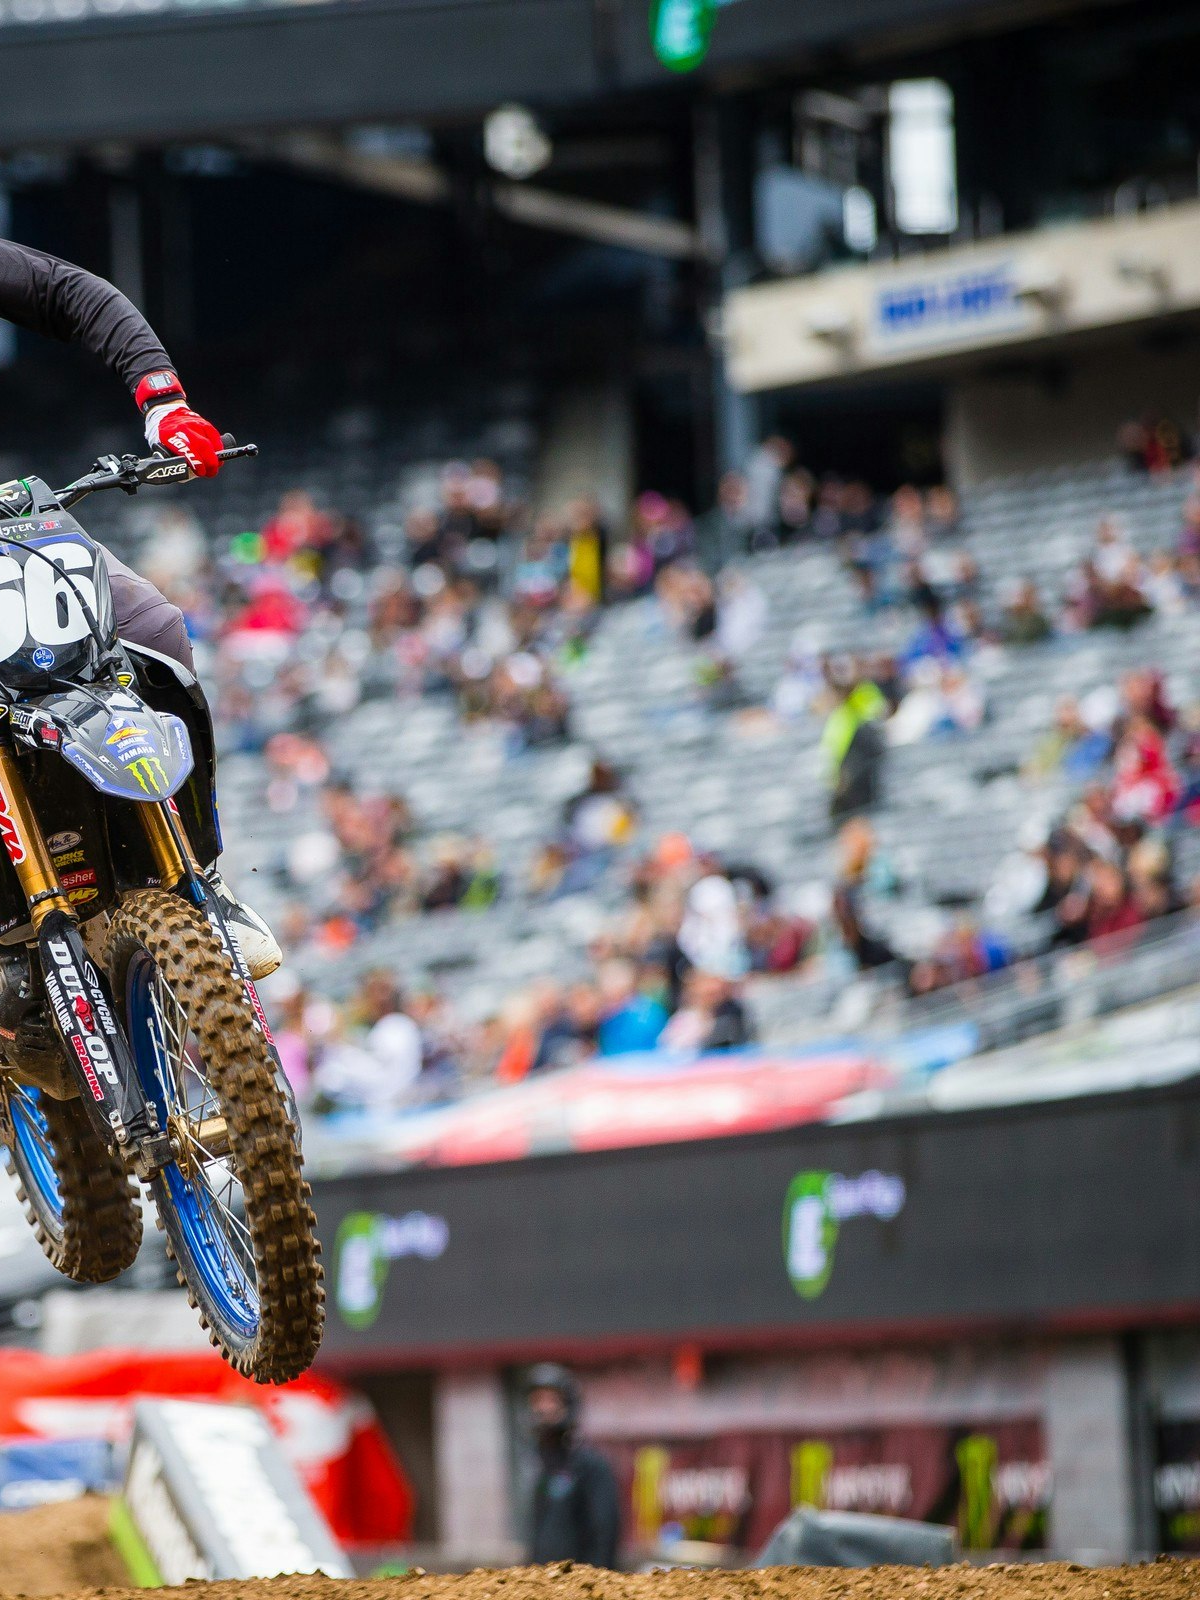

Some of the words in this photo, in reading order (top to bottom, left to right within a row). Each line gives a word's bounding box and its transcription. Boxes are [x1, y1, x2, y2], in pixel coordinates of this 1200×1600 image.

[146, 463, 187, 479] ARC
[118, 745, 156, 763] YAMAHA
[61, 872, 94, 887] ssher
[45, 971, 75, 1036] YAMALUBE
[90, 988, 117, 1036] CYCRA
[71, 1034, 105, 1101] BRAKING
